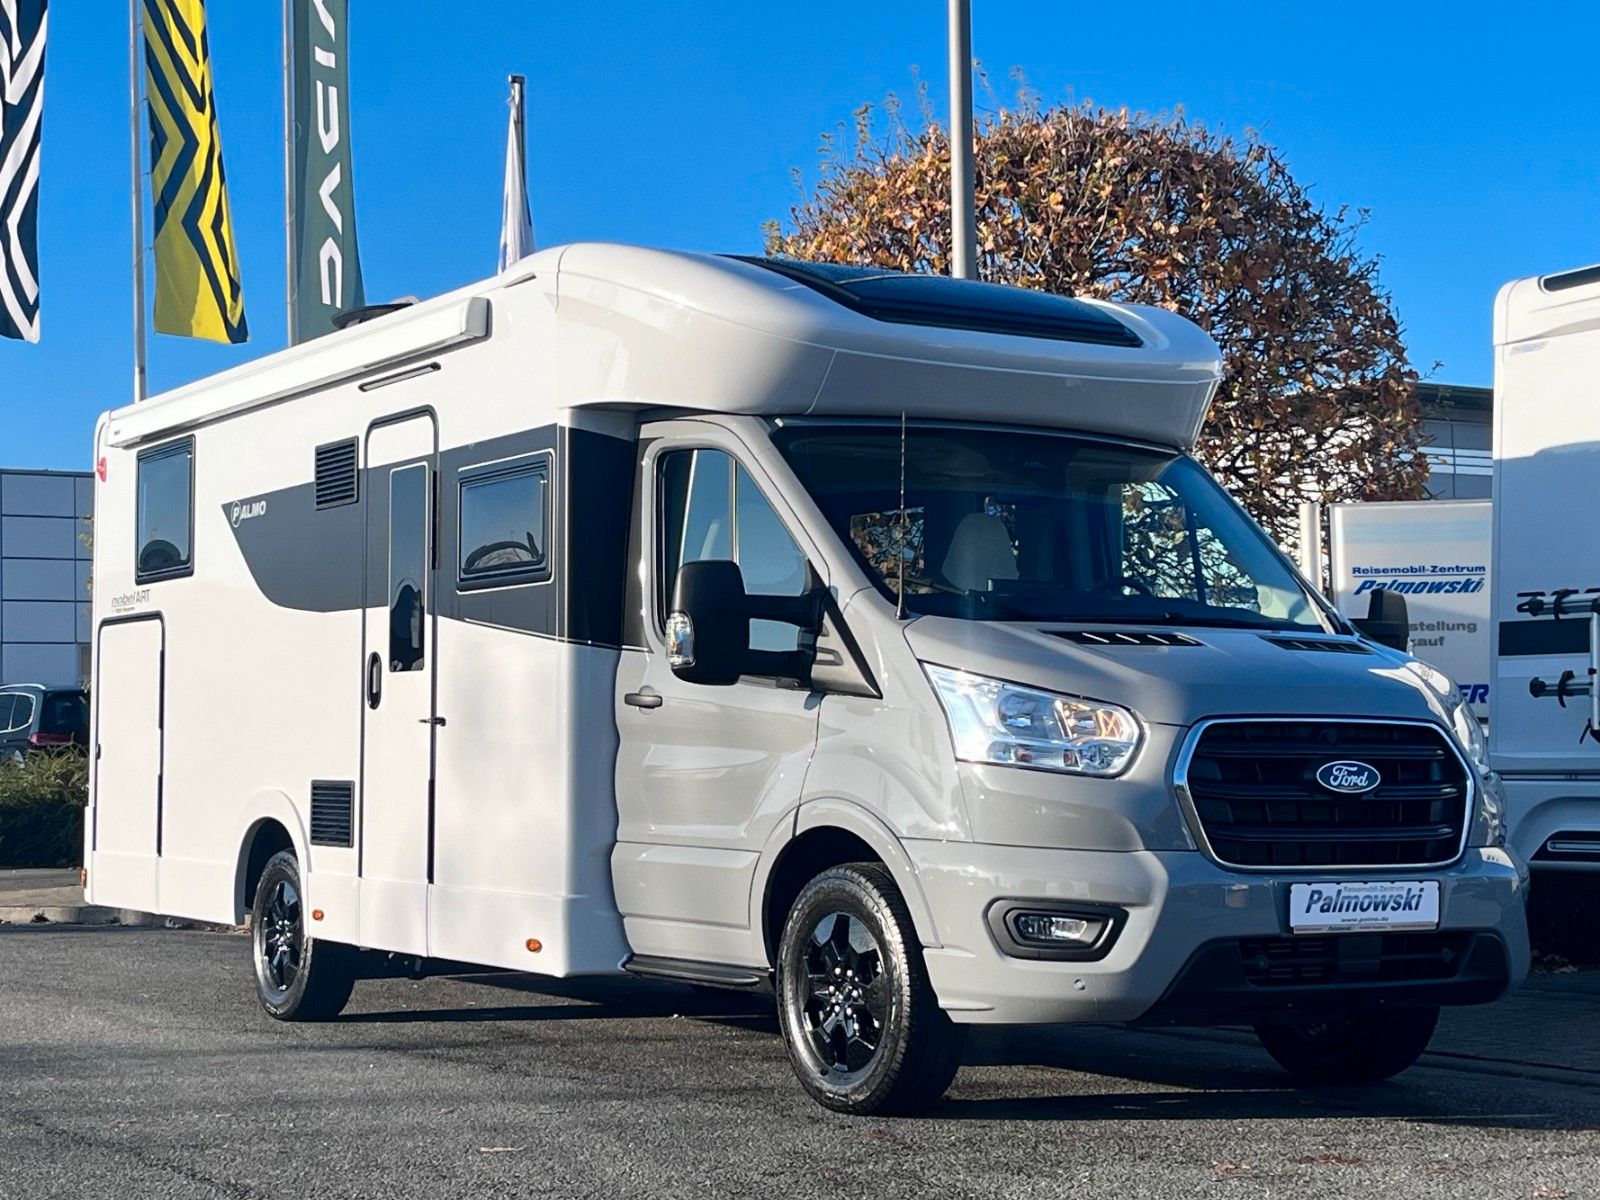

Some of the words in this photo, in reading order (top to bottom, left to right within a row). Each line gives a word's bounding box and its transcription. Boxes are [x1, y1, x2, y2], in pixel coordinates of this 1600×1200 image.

[1409, 621, 1477, 633] stellung
[1330, 765, 1369, 787] Ford
[1305, 887, 1424, 914] Palmowski
